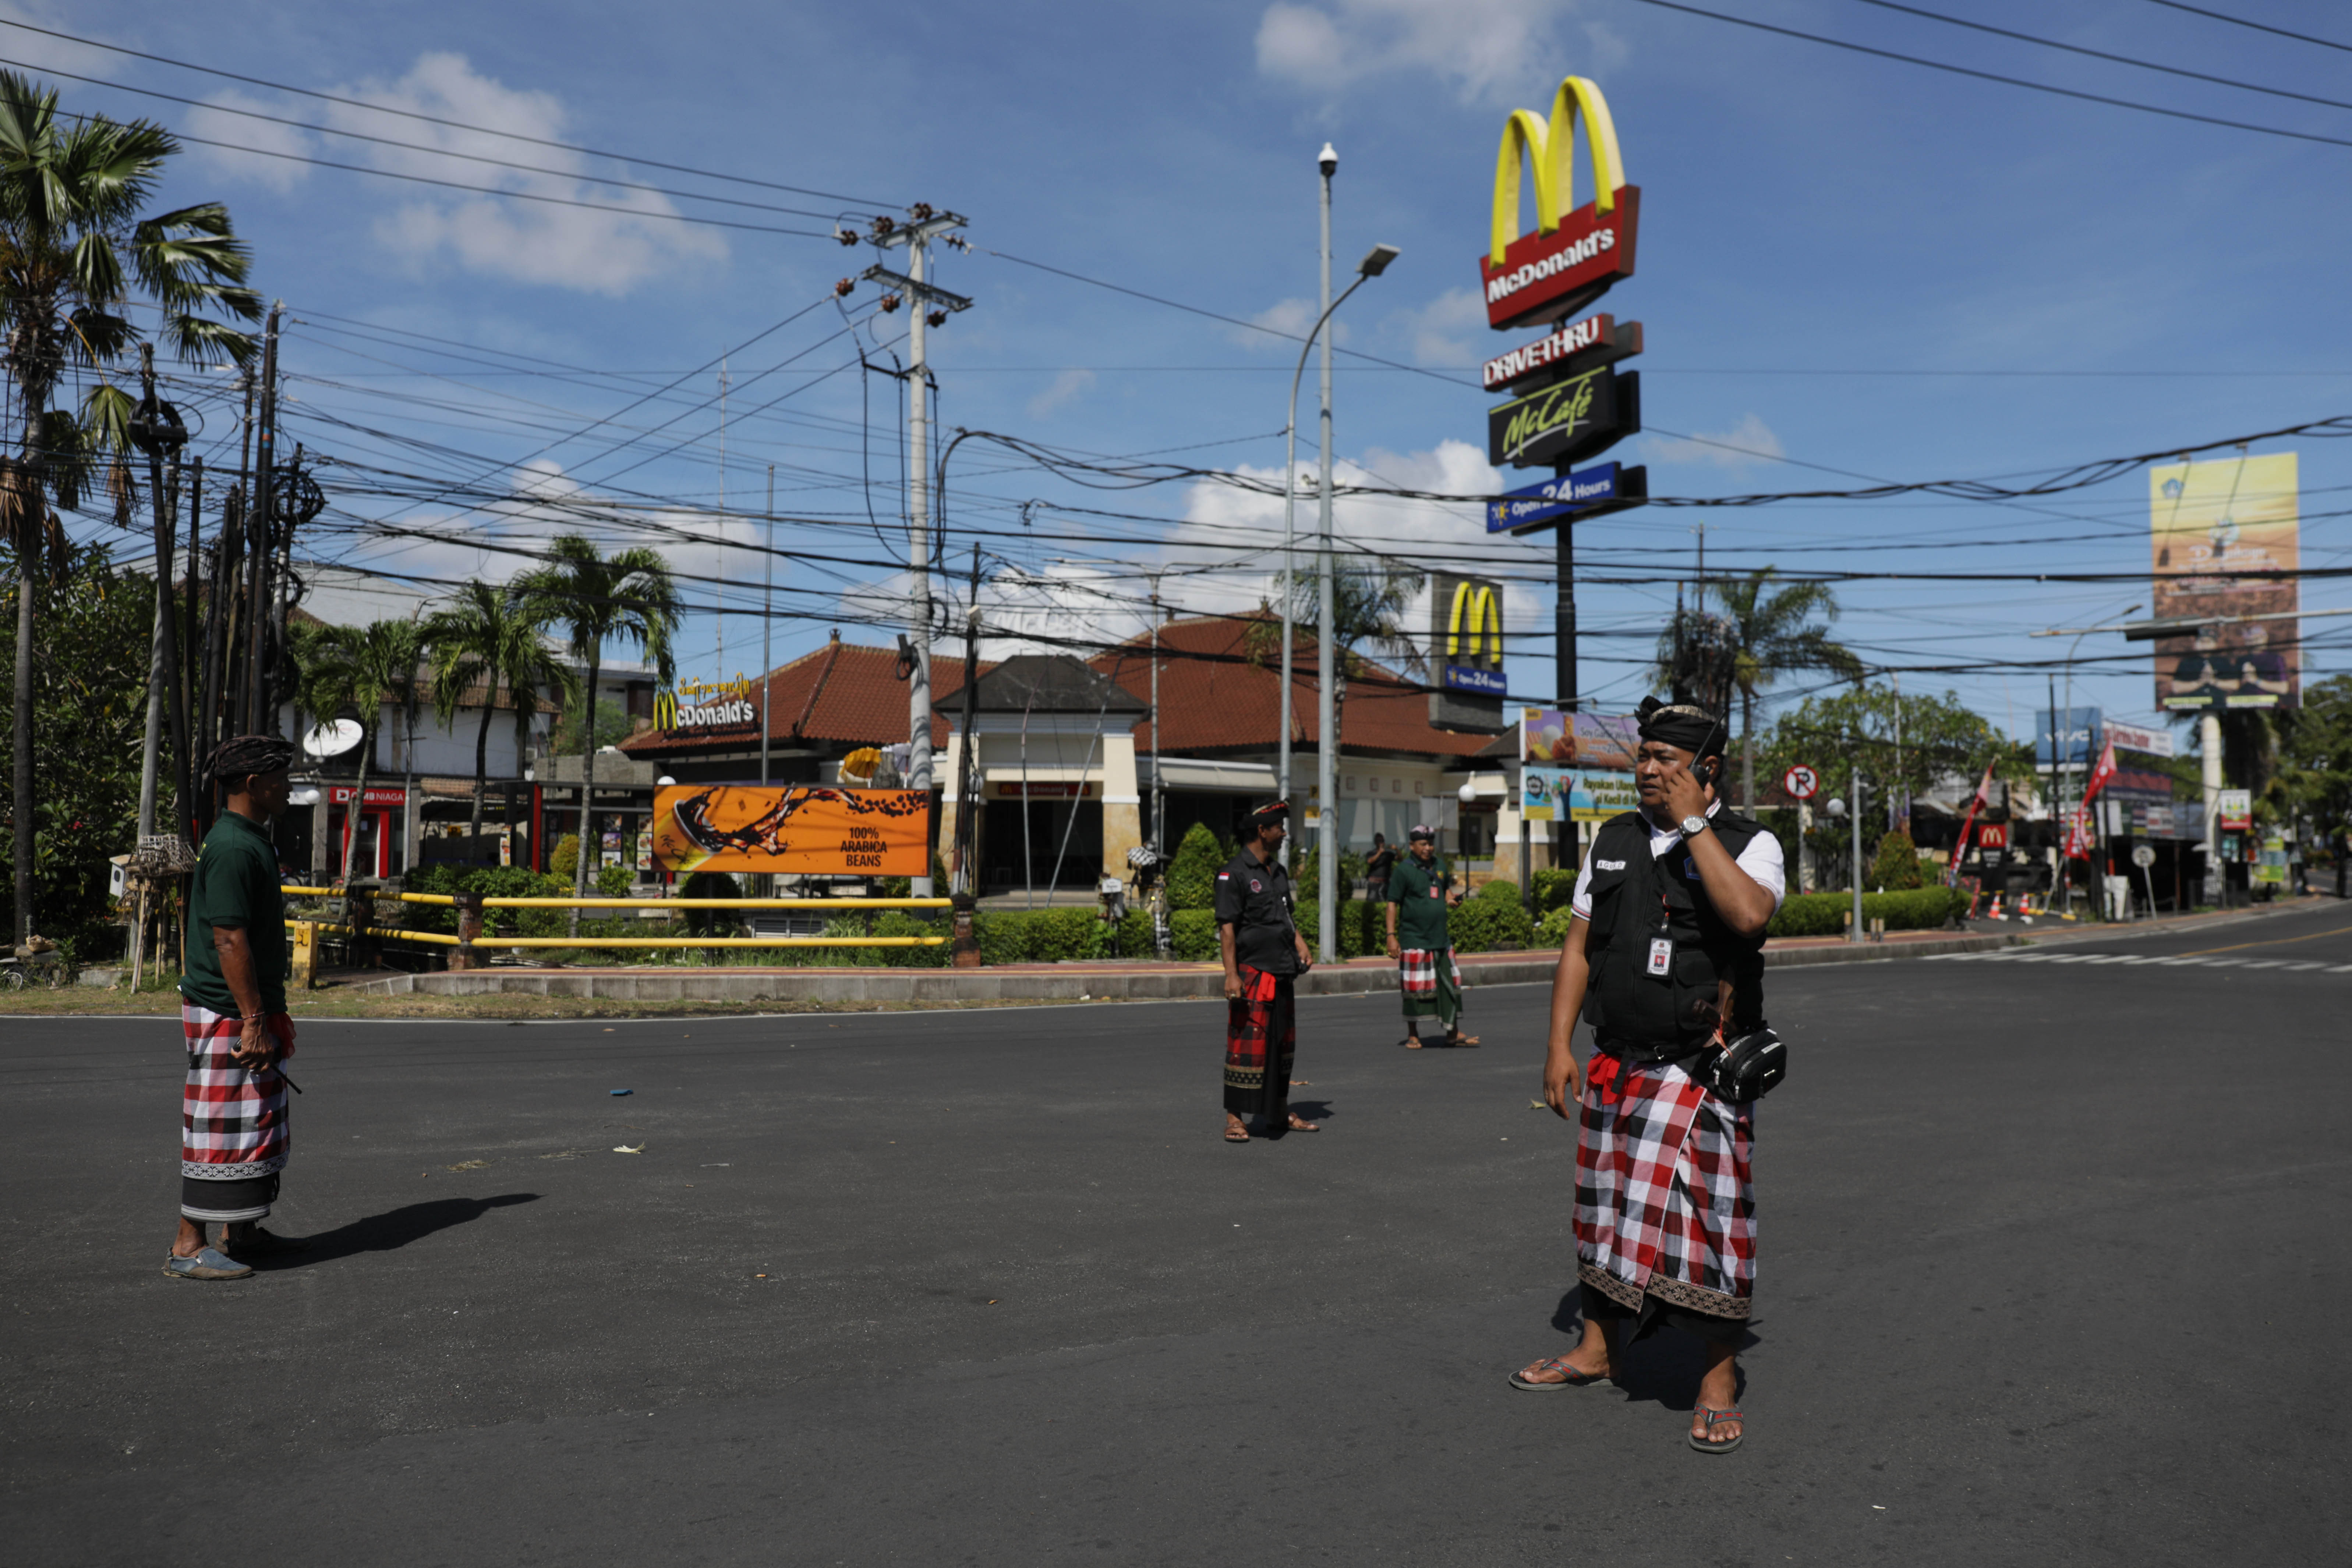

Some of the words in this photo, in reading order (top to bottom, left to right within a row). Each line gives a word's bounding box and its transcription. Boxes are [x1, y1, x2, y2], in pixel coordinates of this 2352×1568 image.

[1488, 228, 1614, 304] McDonald's
[1503, 377, 1594, 457] McCafé
[1511, 501, 1541, 517] Open
[1542, 479, 1573, 507] 24
[1575, 479, 1611, 499] Hours
[1474, 672, 1489, 687] 24
[654, 690, 753, 731] McDonald's
[351, 792, 375, 801] CMB
[376, 793, 403, 801] NIAGA
[849, 827, 879, 839] 100%
[840, 840, 887, 853] ARABICA
[846, 854, 881, 867] BEANS
